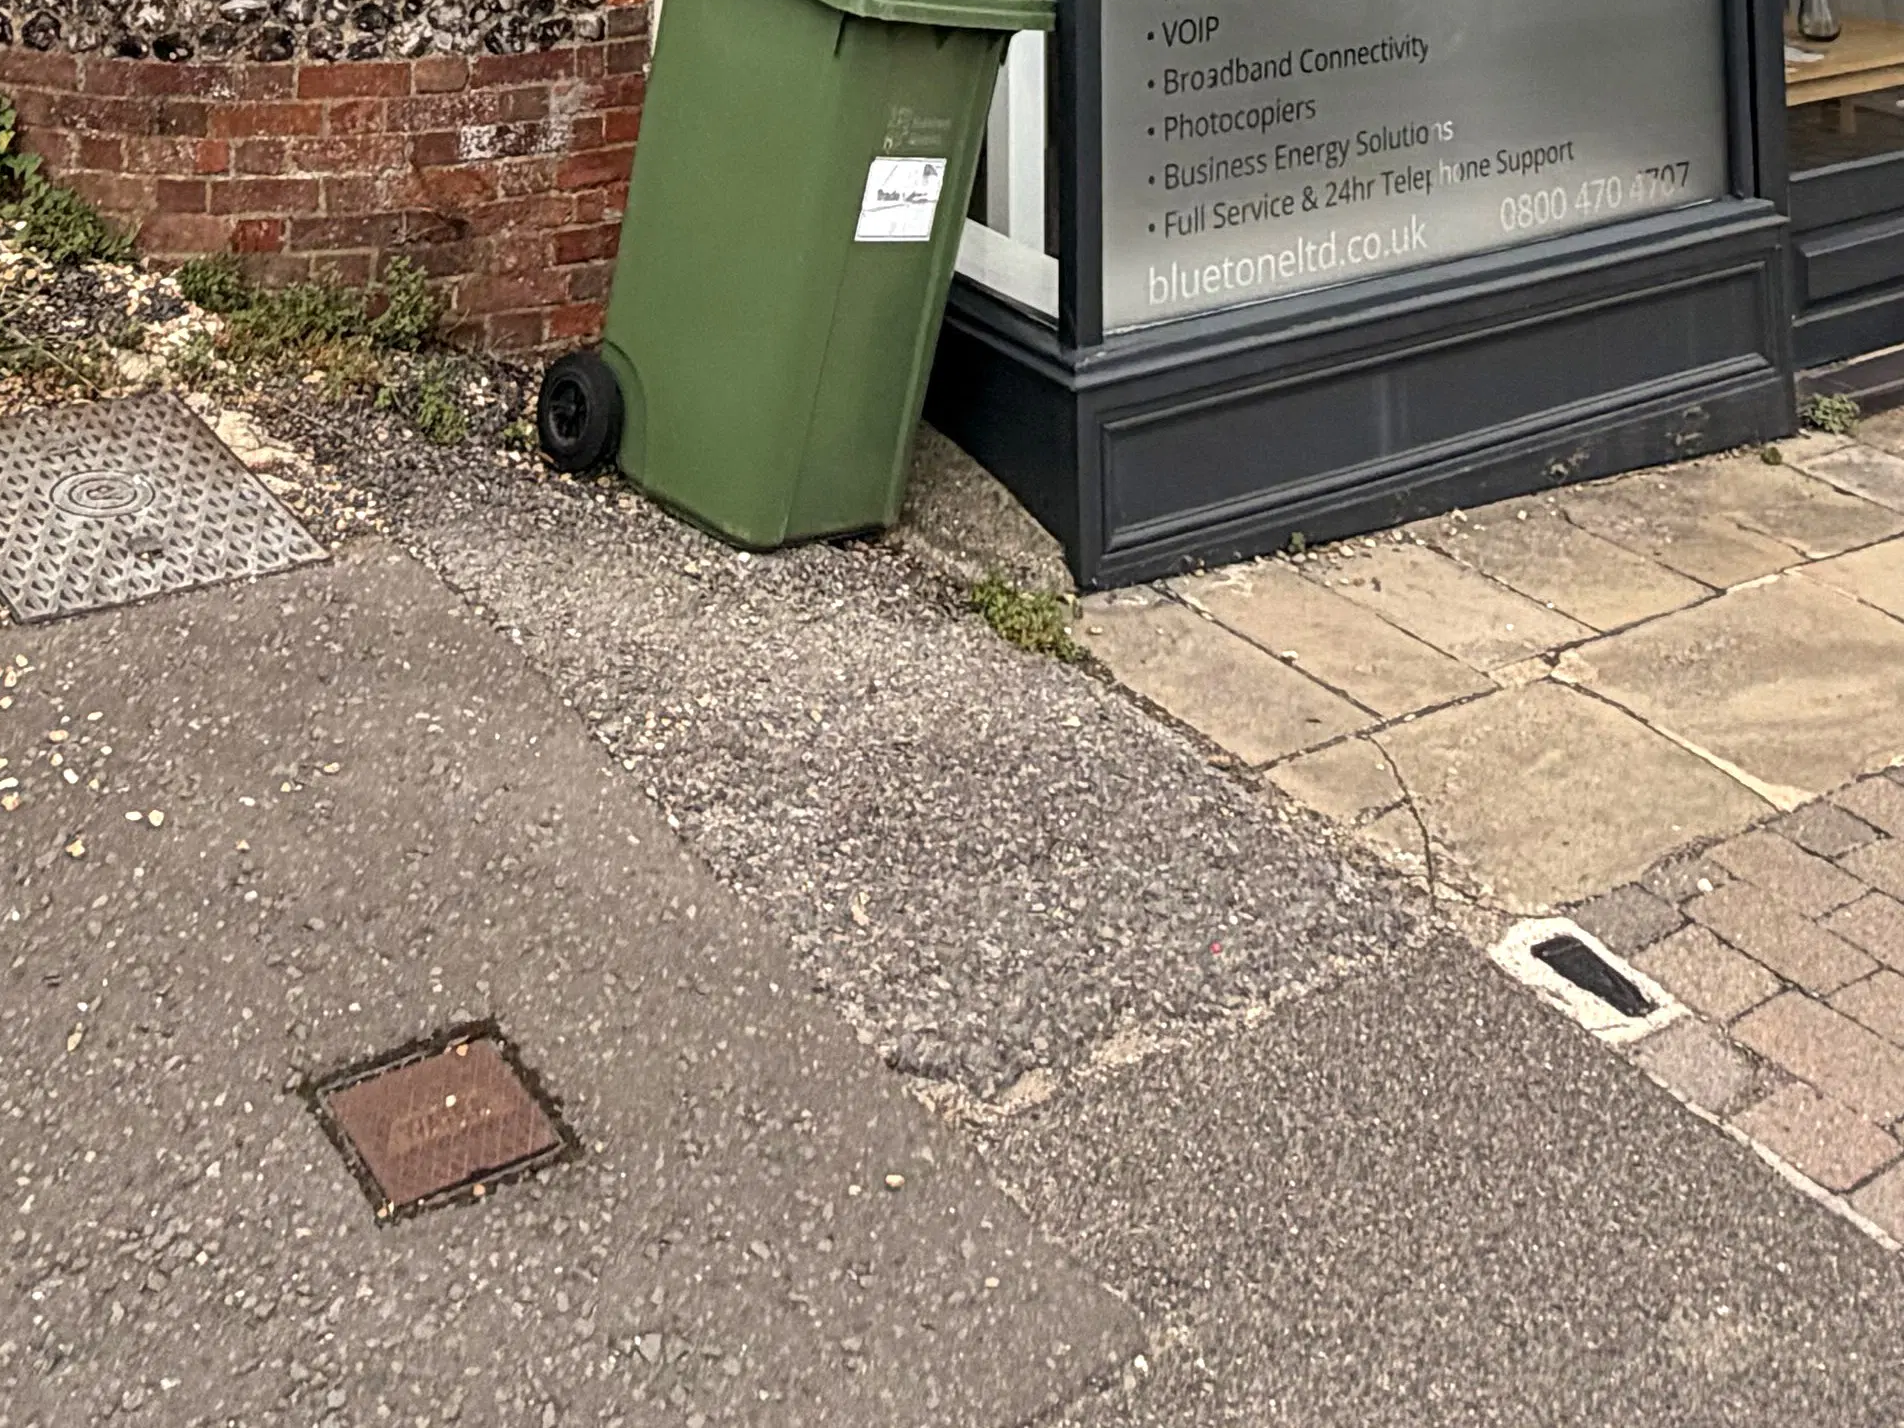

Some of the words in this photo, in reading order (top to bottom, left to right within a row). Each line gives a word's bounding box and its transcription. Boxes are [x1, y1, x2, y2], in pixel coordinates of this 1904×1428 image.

[1162, 16, 1220, 47] VOIP
[1163, 51, 1292, 95] Broadband
[1299, 34, 1429, 73] Connectivity
[1164, 98, 1317, 142] Photocopiers
[1164, 153, 1267, 190] Business
[1275, 138, 1350, 169] Energy
[1165, 204, 1205, 238] Full
[1213, 193, 1295, 229] Service
[1301, 185, 1318, 212] &
[1325, 175, 1376, 208] 24hr
[1496, 141, 1575, 175] Support
[1149, 214, 1428, 305] bluetoneltd.co.uk
[1499, 186, 1567, 232] 0800
[1574, 175, 1623, 215] 470
